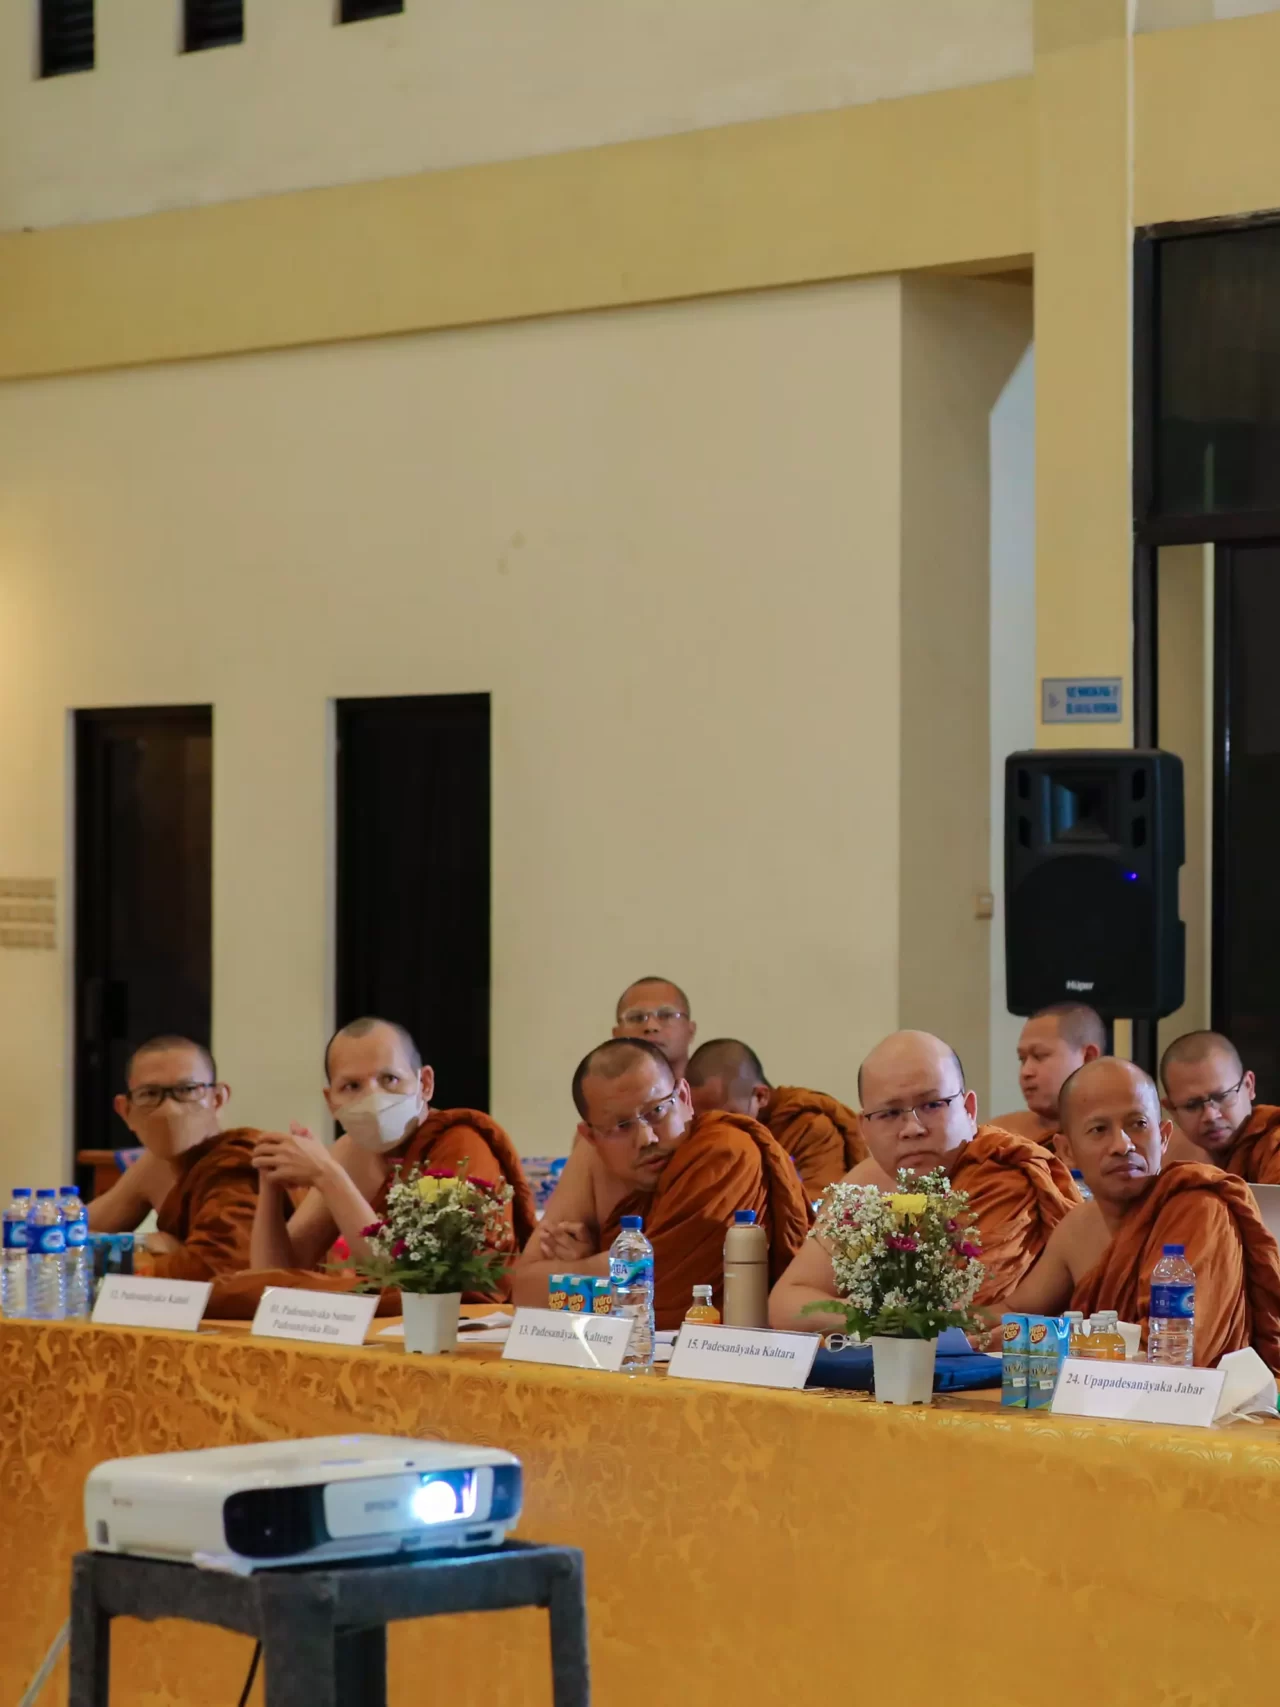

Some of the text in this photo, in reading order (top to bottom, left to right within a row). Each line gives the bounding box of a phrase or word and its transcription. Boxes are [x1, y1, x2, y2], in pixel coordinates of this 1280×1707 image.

[687, 1339, 795, 1359] 15. Padesanāyaka Kaltara
[1066, 1373, 1080, 1385] 24.
[1083, 1374, 1173, 1393] Upapadesanāyaka
[1174, 1381, 1206, 1395] Jabar
